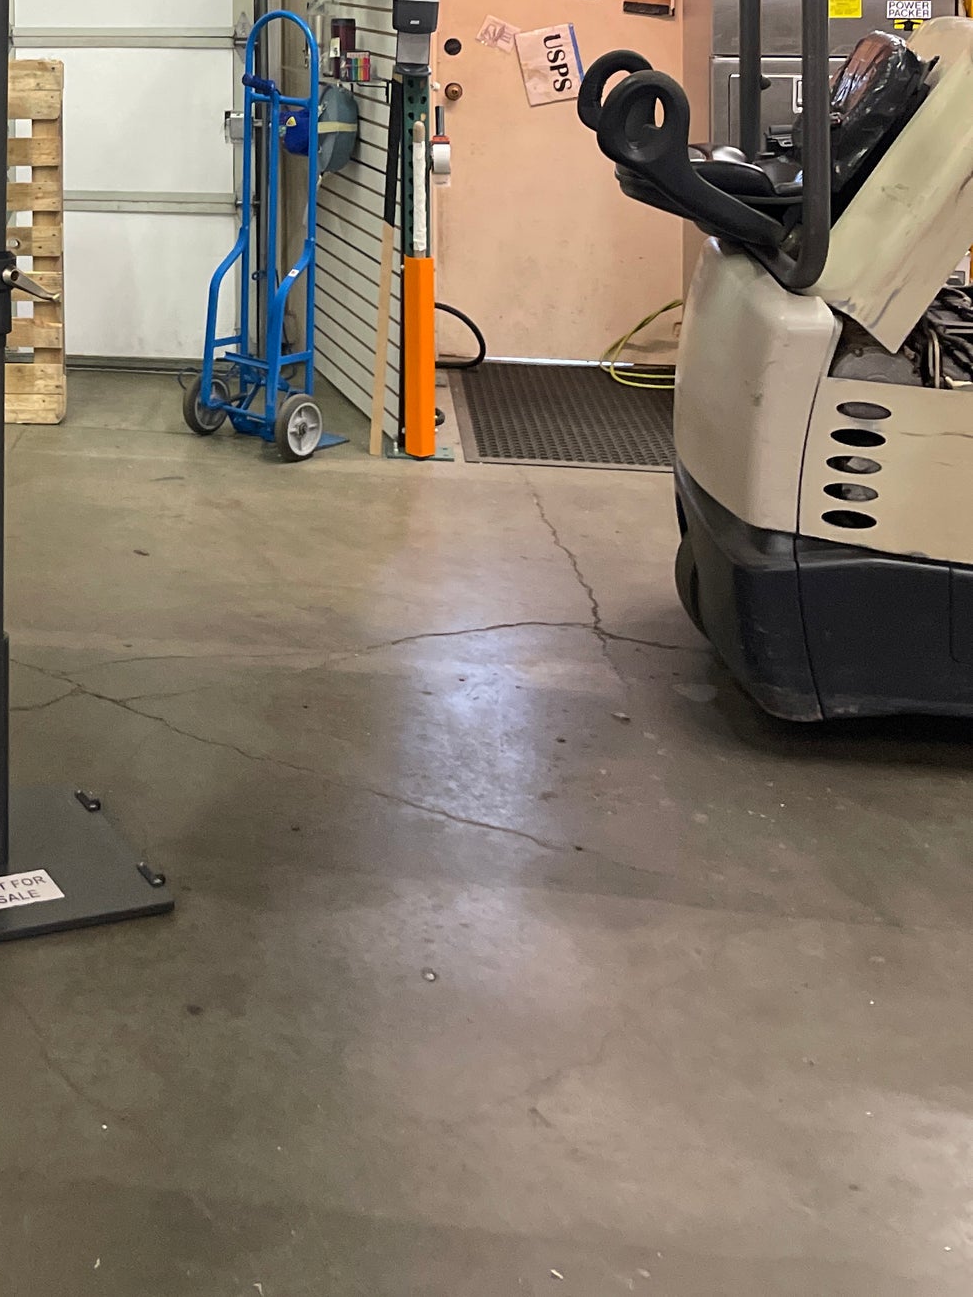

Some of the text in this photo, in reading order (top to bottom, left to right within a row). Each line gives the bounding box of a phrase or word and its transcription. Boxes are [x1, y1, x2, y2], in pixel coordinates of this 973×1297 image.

[889, 9, 930, 18] PACKER
[543, 33, 573, 93] USPS
[10, 875, 47, 888] FOR
